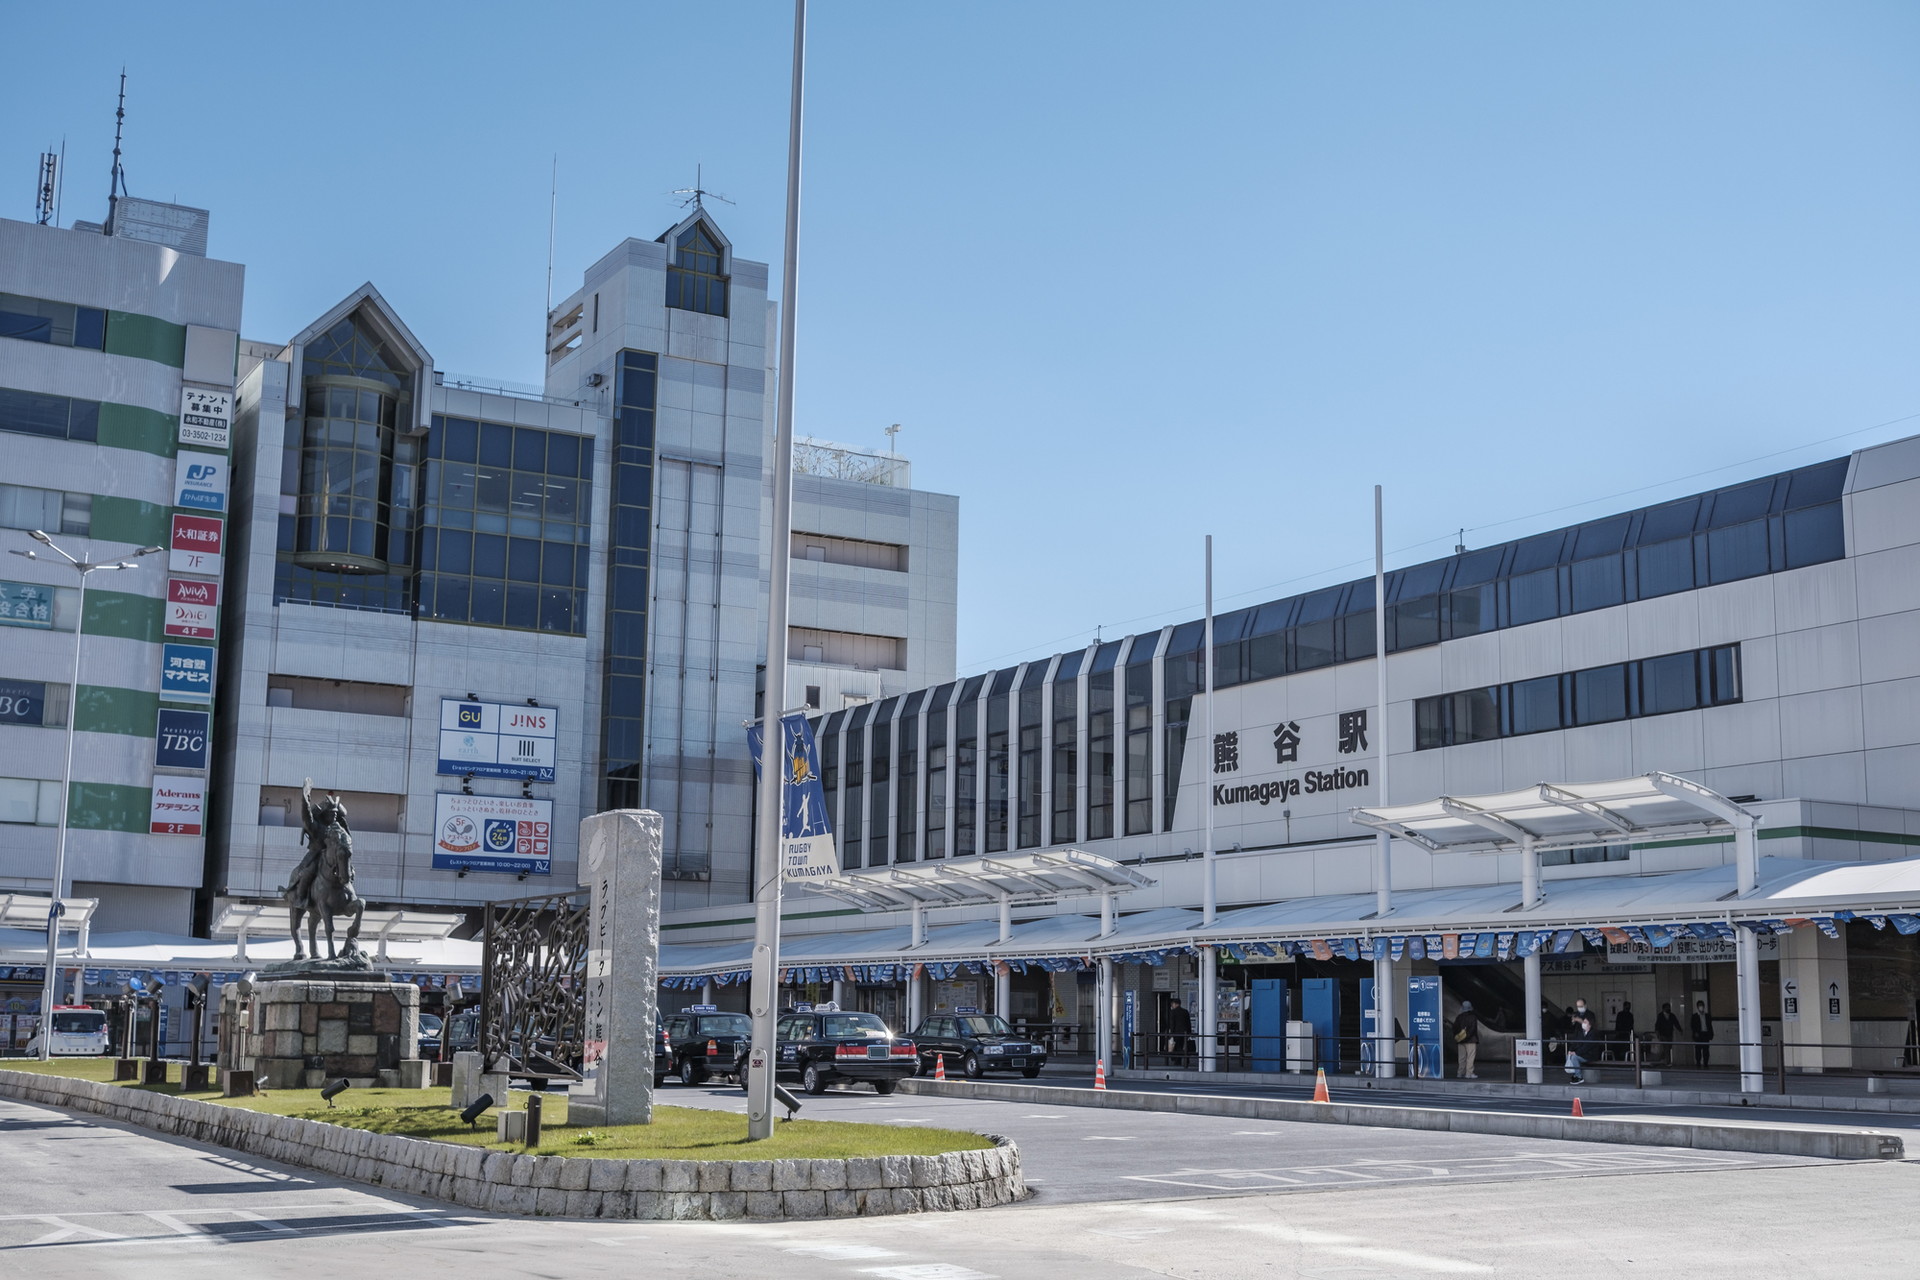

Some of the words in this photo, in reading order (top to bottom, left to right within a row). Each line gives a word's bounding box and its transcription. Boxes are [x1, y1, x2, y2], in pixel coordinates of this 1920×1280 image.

[187, 392, 228, 405] テナント
[191, 402, 223, 415] 募集中
[182, 429, 226, 442] 03-3502-1234
[184, 480, 213, 488] INSURANCE
[176, 528, 219, 542] 大和証券
[187, 555, 204, 567] 7F
[182, 626, 198, 635] 4F
[170, 657, 206, 670] 河合塾
[164, 670, 209, 683] マナビス
[460, 711, 481, 723] GU
[163, 727, 204, 735] Aesthetic
[162, 734, 203, 752] TBC
[1213, 709, 1368, 774] 熊谷駅
[1213, 778, 1299, 806] Kumagaya
[1304, 766, 1369, 794] Station
[156, 789, 201, 799] Aderans
[155, 803, 200, 812] アデランス
[455, 817, 466, 826] 5F
[168, 824, 184, 833] 2F
[788, 843, 812, 854] RUGBY
[788, 855, 808, 866] TOWN
[786, 864, 833, 878] KUMAGAYA
[1574, 959, 1588, 970] 4F
[593, 879, 608, 1066] ラグビータウン熊谷
